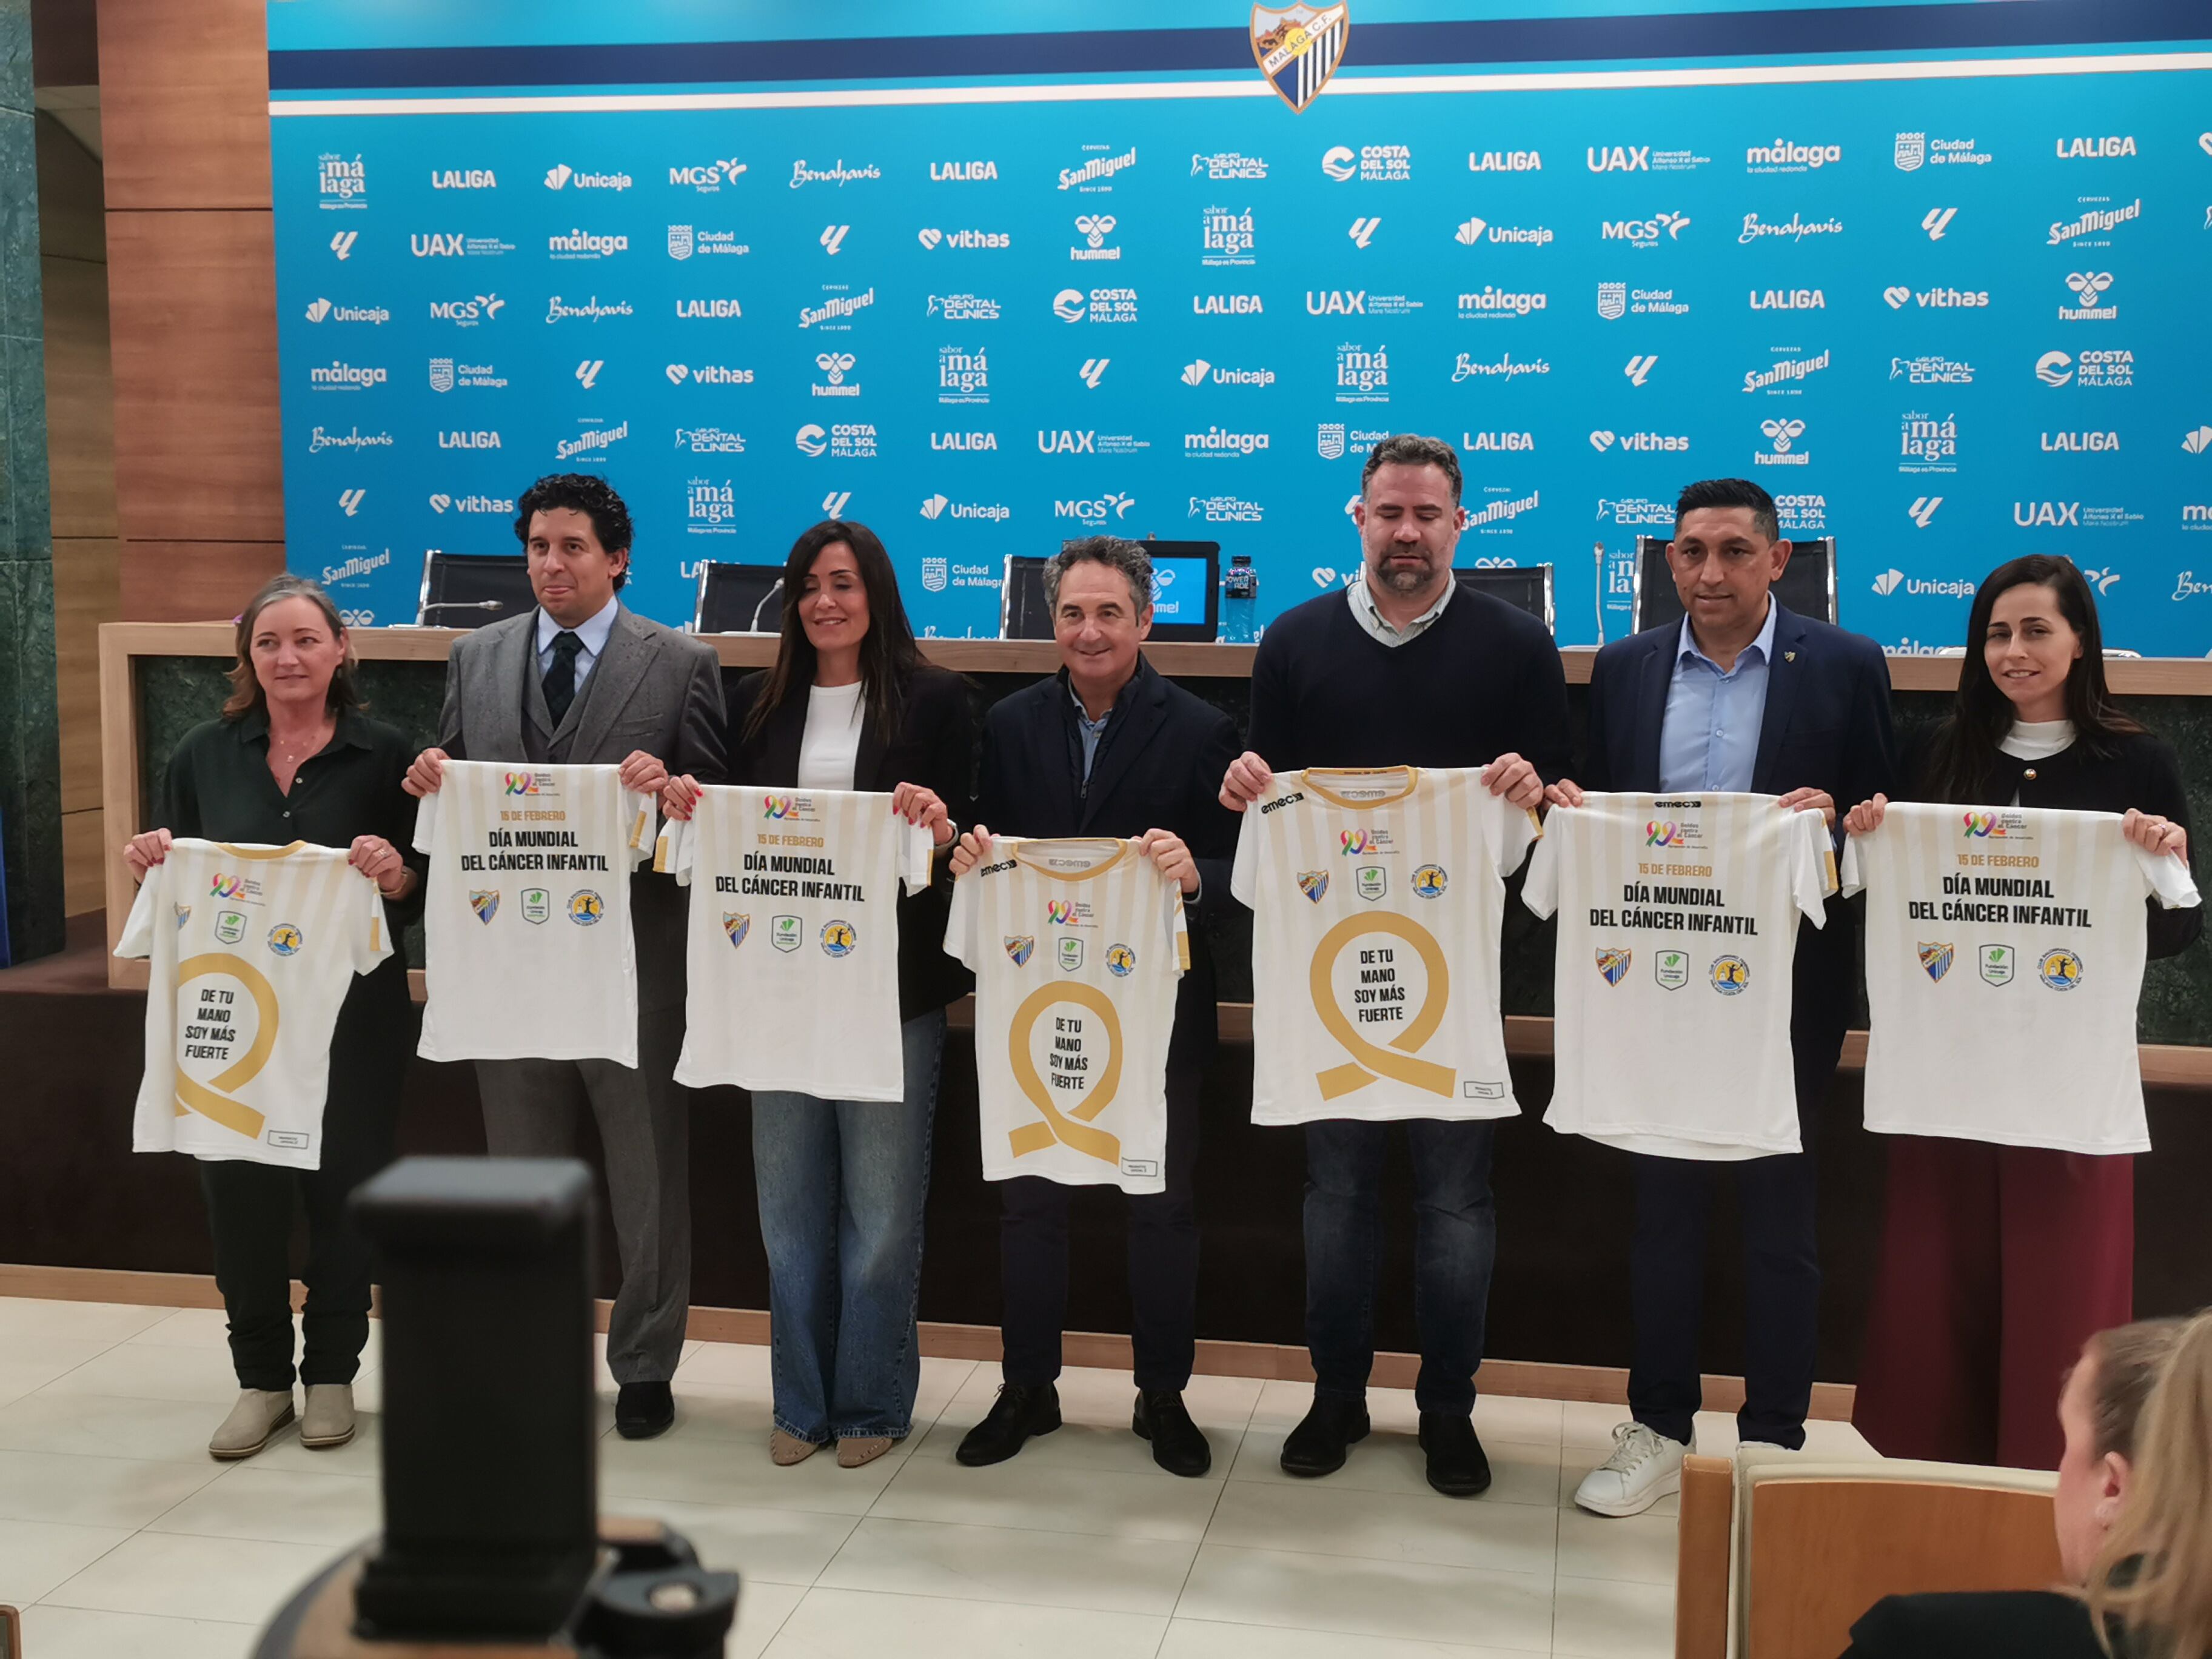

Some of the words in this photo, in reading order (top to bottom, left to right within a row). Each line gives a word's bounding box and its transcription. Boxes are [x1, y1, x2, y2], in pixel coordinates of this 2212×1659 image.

[1361, 146, 1410, 159] COSTA
[1931, 139, 1974, 151] Ciudad
[2057, 136, 2136, 158] LALIGA
[1209, 159, 1269, 169] DENTAL
[1361, 158, 1384, 171] DEL
[1387, 158, 1410, 170] SOL
[1469, 151, 1541, 171] LALIGA
[1587, 146, 1649, 173] UAX
[1930, 153, 1946, 164] de
[1948, 152, 1992, 165] Málaga
[432, 170, 496, 189] LALIGA
[669, 166, 720, 186] MGS
[931, 161, 997, 181] LALIGA
[1209, 169, 1267, 179] CLINICS
[1361, 169, 1410, 180] MÁLAGA
[574, 172, 632, 192] Unicaja
[698, 232, 734, 241] Ciudad
[947, 230, 1010, 248] vithas
[1489, 226, 1553, 246] Unicaja
[1602, 221, 1659, 240] MGS
[412, 233, 464, 256] UAX
[698, 244, 711, 253] de
[712, 243, 749, 255] Málaga
[1071, 245, 1121, 260] hummel
[1090, 289, 1137, 301] COSTA
[1307, 290, 1366, 315] UAX
[1632, 290, 1672, 301] Ciudad
[1750, 290, 1825, 310] LALIGA
[1916, 288, 1989, 307] vithas
[431, 302, 479, 319] MGS
[677, 300, 741, 318] LALIGA
[944, 299, 1000, 309] DENTAL
[1090, 302, 1112, 313] DEL
[1114, 302, 1137, 312] SOL
[1194, 295, 1263, 313] LALIGA
[1631, 303, 1646, 312] de
[1648, 302, 1689, 314] Málaga
[333, 306, 389, 324] Unicaja
[944, 309, 999, 320] CLINICS
[1090, 311, 1137, 322] MÁLAGA
[2059, 306, 2117, 320] hummel
[2080, 351, 2133, 364] COSTA
[693, 366, 754, 383] vithas
[1910, 363, 1975, 372] DENTAL
[2079, 363, 2104, 377] DEL
[2107, 363, 2133, 375] SOL
[1213, 369, 1275, 387] Unicaja
[1336, 363, 1388, 392] laga
[1909, 372, 1972, 383] CLINICS
[2078, 375, 2132, 386] MÁLAGA
[812, 382, 860, 396] hummel
[439, 431, 501, 448] LALIGA
[931, 432, 997, 450] LALIGA
[1039, 431, 1094, 453] UAX
[1464, 432, 1534, 451] LALIGA
[1620, 432, 1689, 451] vithas
[1901, 432, 1957, 461] laga
[2041, 432, 2119, 451] LALIGA
[1755, 450, 1809, 464] hummel
[455, 496, 514, 512] vithas
[951, 503, 1010, 522] Unicaja
[1055, 501, 1107, 518] MGS
[2014, 502, 2079, 526] UAX
[1907, 579, 1975, 598] Unicaja
[511, 811, 521, 820] DE
[525, 811, 565, 820] FEBRERO
[489, 828, 512, 847] DÍA
[515, 831, 578, 847] MUNDIAL
[757, 834, 766, 844] 15
[768, 834, 779, 845] DE
[782, 836, 824, 848] FEBRERO
[461, 855, 486, 871] DEL
[489, 851, 543, 870] CÁNCER
[547, 854, 608, 871] INFANTIL
[745, 851, 767, 871] DÍA
[771, 856, 834, 875] MUNDIAL
[1958, 854, 1968, 865] 15
[1971, 855, 1984, 865] DE
[1988, 856, 2039, 868] FEBRERO
[1639, 863, 1649, 874] 15
[1651, 863, 1663, 874] DE
[1666, 864, 1712, 877] FEBRERO
[716, 876, 739, 893] DEL
[742, 874, 798, 896] CÁNCER
[802, 881, 865, 902] INFANTIL
[1624, 881, 1650, 903] DÍA
[1654, 886, 1724, 907] MUNDIAL
[1943, 873, 1971, 895] DÍA
[1975, 878, 2054, 898] MUNDIAL
[1590, 909, 1618, 927] DEL
[1622, 907, 1684, 930] CÁNCER
[1688, 914, 1758, 936] INFANTIL
[1909, 902, 1939, 920] DEL
[1942, 899, 2008, 922] CÁNCER
[2014, 905, 2091, 927] INFANTIL
[1361, 950, 1375, 964] DE
[1378, 949, 1393, 962] TU
[1361, 968, 1395, 984] MANO
[201, 989, 216, 1002] DE
[220, 991, 234, 1004] TU
[1355, 990, 1376, 1003] SOY
[1379, 984, 1405, 1001] MÁS
[197, 1008, 230, 1022] MANO
[1359, 1007, 1403, 1022] FUERTE
[1056, 1017, 1065, 1031] DE
[1067, 1020, 1081, 1033] TU
[186, 1026, 208, 1039] SOY
[210, 1026, 236, 1042] MÁS
[1056, 1036, 1081, 1051] MANO
[186, 1045, 229, 1060] FUERTE
[1050, 1053, 1063, 1068] SOY
[1065, 1055, 1088, 1070] MÁS
[1051, 1073, 1084, 1089] FUERTE
